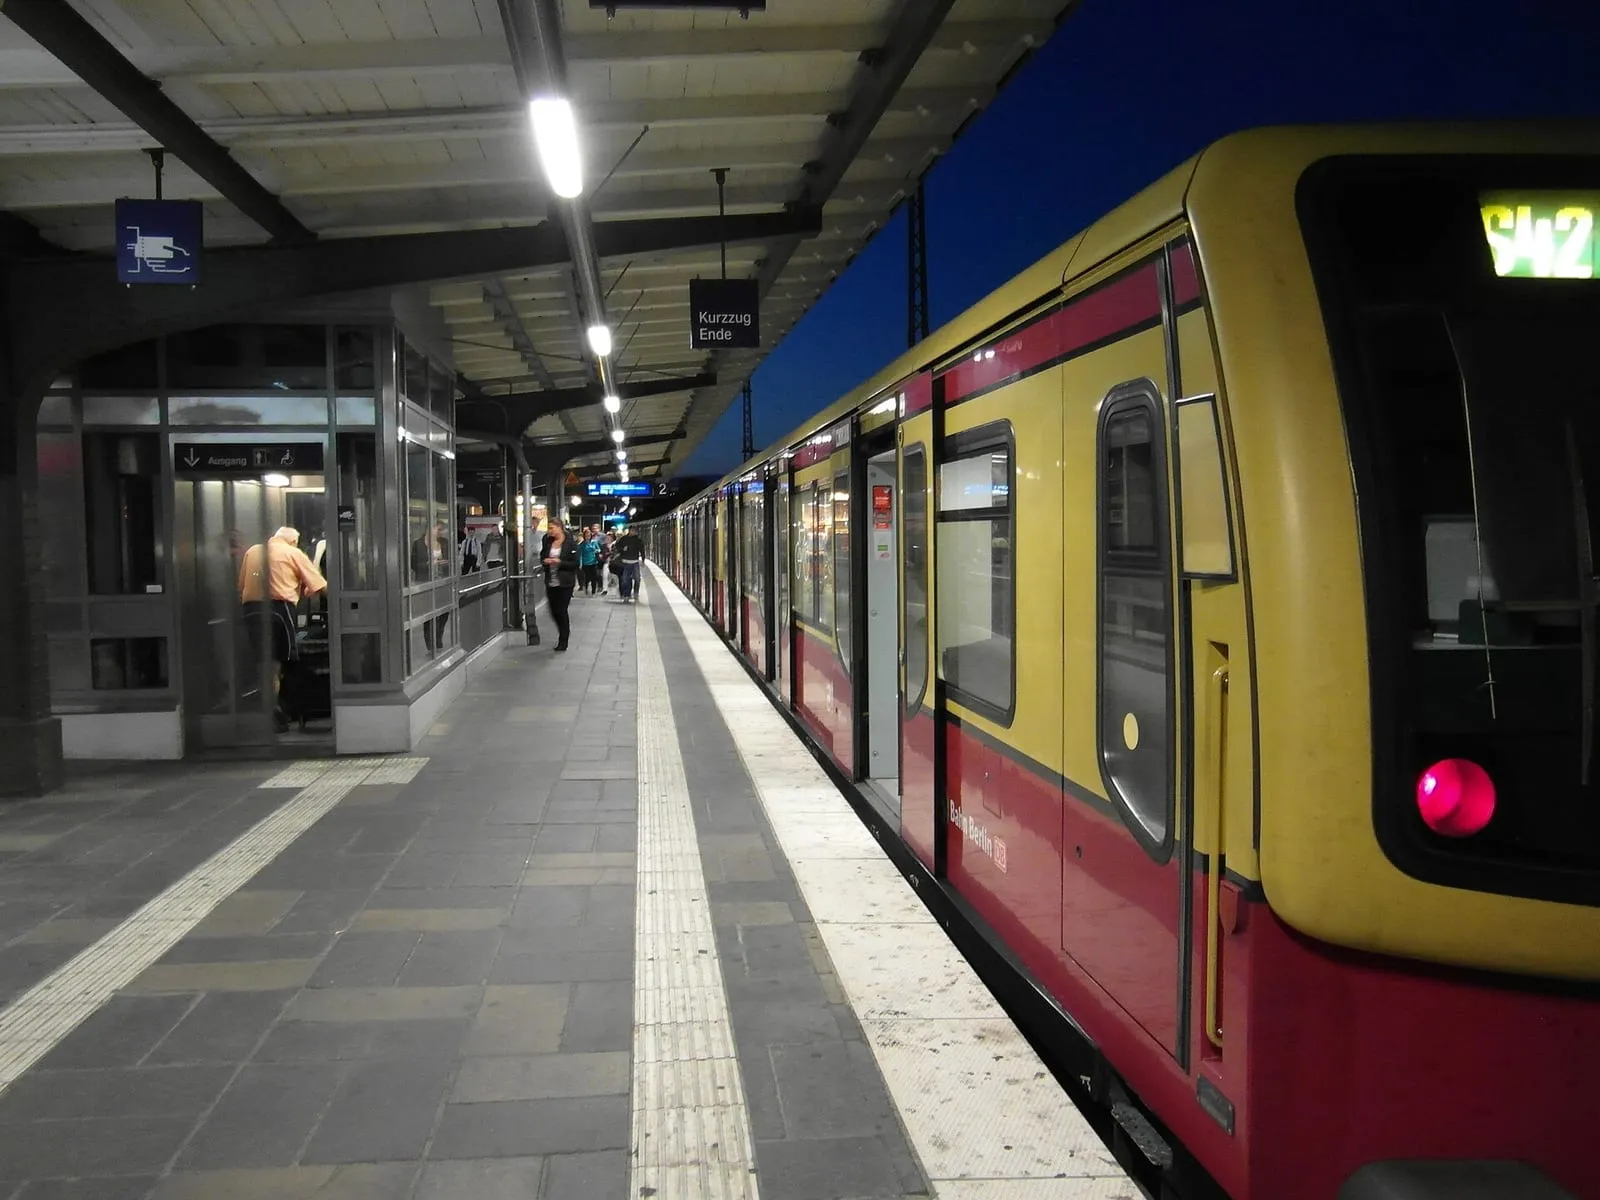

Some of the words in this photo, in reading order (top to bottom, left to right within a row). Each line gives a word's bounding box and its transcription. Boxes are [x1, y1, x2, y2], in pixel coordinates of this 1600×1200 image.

[699, 311, 752, 326] Kurzzug
[699, 328, 732, 340] Ende
[208, 456, 247, 466] Ausgang
[658, 483, 667, 495] 2
[969, 815, 993, 859] Berlin
